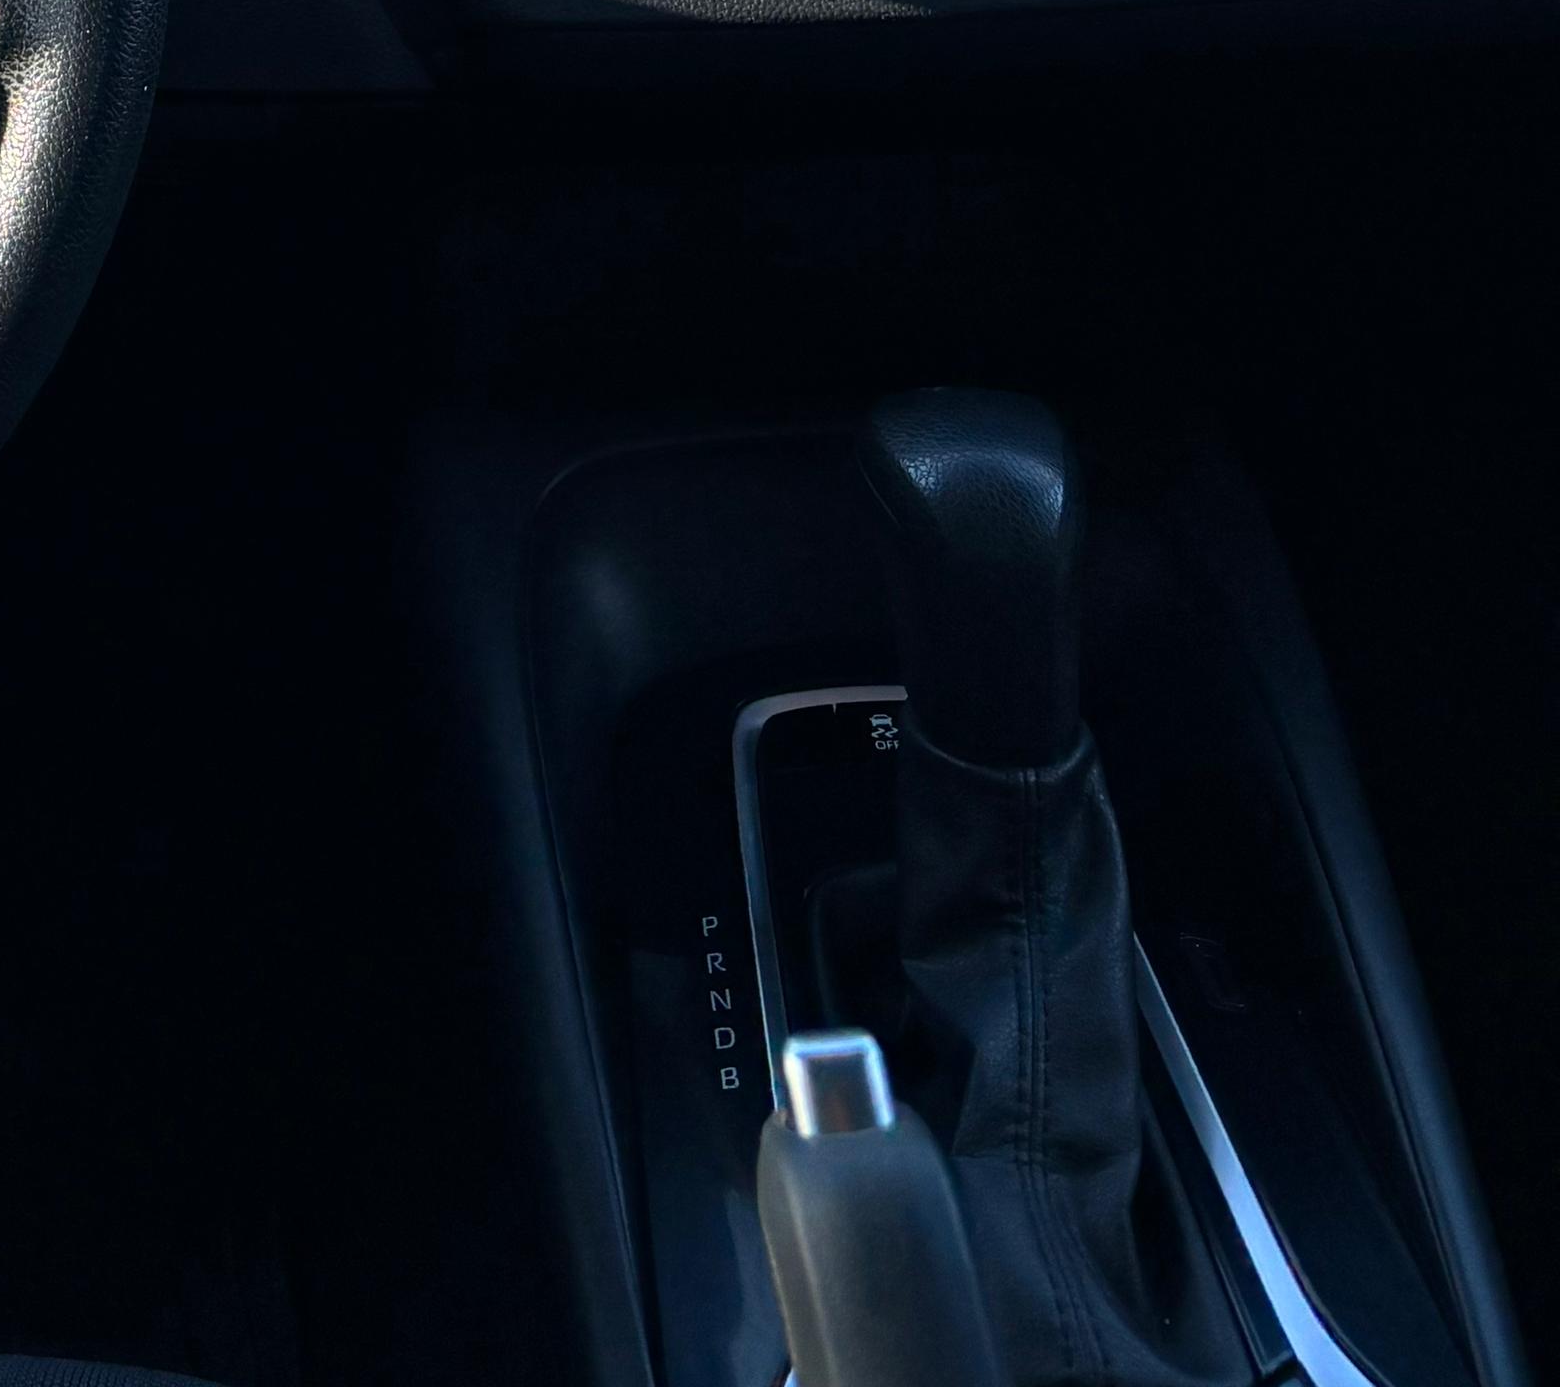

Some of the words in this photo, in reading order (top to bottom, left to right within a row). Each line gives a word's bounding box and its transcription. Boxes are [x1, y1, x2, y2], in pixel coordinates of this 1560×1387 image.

[874, 739, 900, 751] OFF
[701, 915, 719, 938] P
[706, 951, 728, 975] R
[709, 987, 732, 1012] N
[713, 1026, 737, 1050] D
[719, 1066, 741, 1090] B
